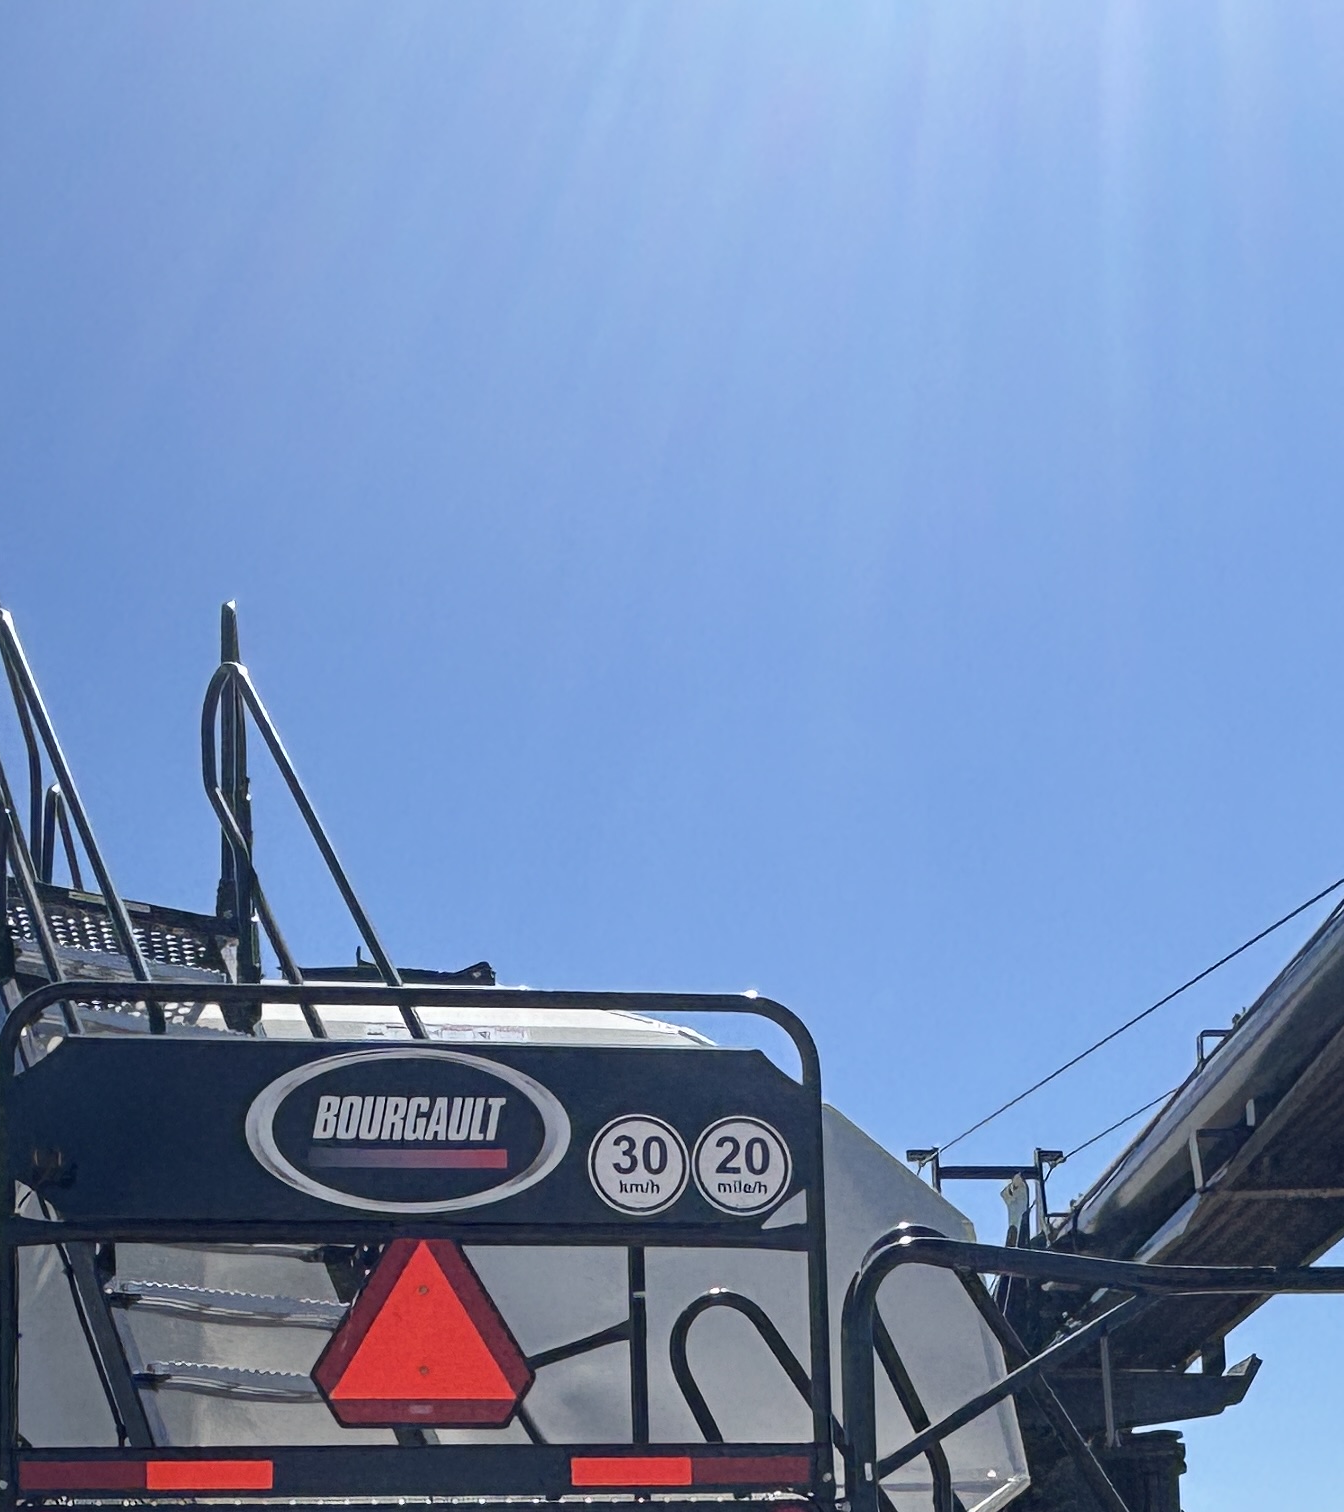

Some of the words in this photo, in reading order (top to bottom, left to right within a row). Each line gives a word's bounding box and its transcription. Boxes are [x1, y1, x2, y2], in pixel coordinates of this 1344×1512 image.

[312, 1095, 507, 1141] BOURGAULT
[612, 1134, 668, 1176] 30
[715, 1135, 770, 1176] 20
[619, 1180, 660, 1194] km/h
[717, 1180, 768, 1195] mile/h
